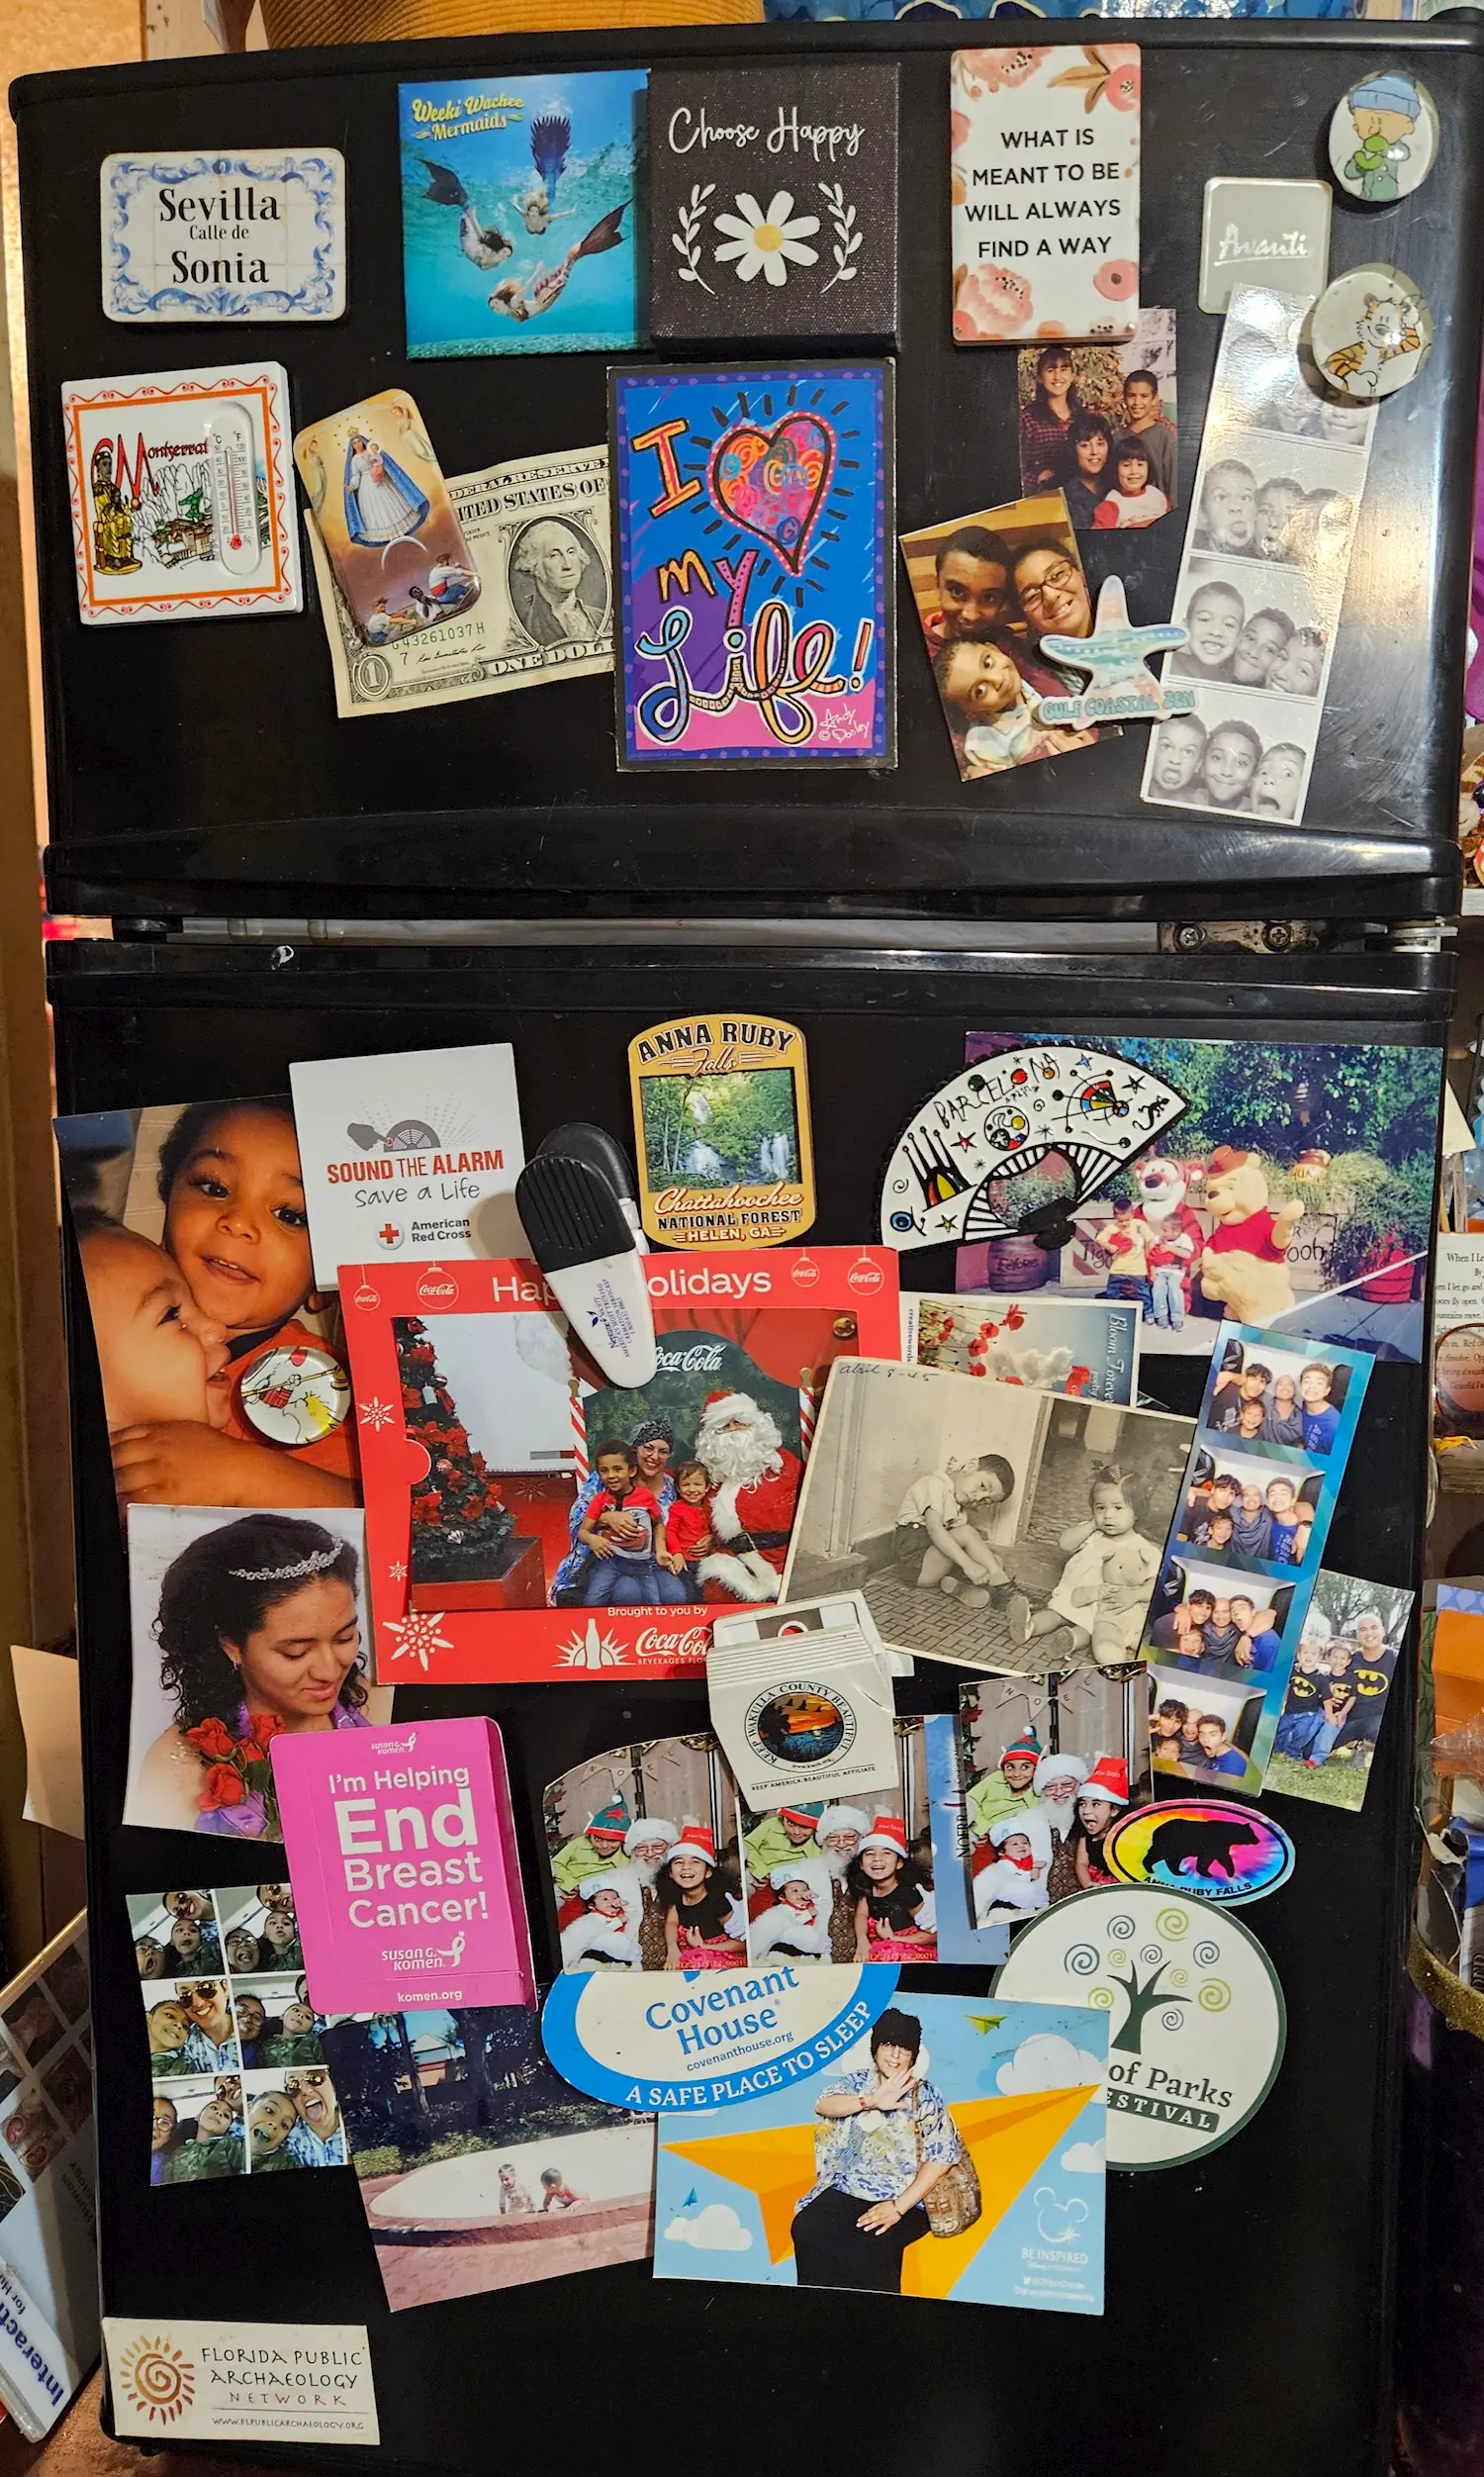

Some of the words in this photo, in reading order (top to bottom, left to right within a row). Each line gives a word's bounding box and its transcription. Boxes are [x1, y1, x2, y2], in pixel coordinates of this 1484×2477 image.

[412, 99, 462, 123] Weeki
[464, 92, 524, 115] Wachee
[431, 113, 508, 142] Mermaids
[668, 107, 760, 153] Choose
[767, 106, 865, 162] Happy
[1001, 130, 1068, 148] WHAT
[1075, 128, 1094, 145] IS
[973, 166, 1049, 186] MEANT
[1055, 164, 1084, 181] TO
[1092, 162, 1120, 180] BE
[158, 186, 281, 223] Sevilla
[965, 204, 1019, 223] WILL
[1026, 199, 1121, 220] ALWAYS
[189, 224, 227, 240] Calle
[232, 224, 249, 239] de
[978, 239, 1029, 257] FIND
[1036, 239, 1052, 255] A
[1059, 237, 1112, 254] WAY
[1218, 224, 1308, 255] Avanti
[171, 249, 270, 284] Sonia
[631, 418, 703, 520] I
[449, 476, 510, 499] DERAL
[458, 498, 501, 524] ITED
[504, 482, 577, 511] STATES
[580, 477, 607, 496] OF
[657, 547, 761, 629] my
[488, 653, 543, 675] ONE
[547, 639, 613, 663] DOLL
[636, 600, 873, 746] Life!
[819, 704, 856, 728] Andy
[1043, 701, 1082, 720] GULF
[1085, 694, 1159, 716] COASTAL
[1162, 690, 1196, 710] ZEN
[637, 1021, 713, 1064] ANNA
[720, 1019, 794, 1054] RUBY
[692, 1045, 739, 1076] Falls
[326, 1160, 394, 1184] SOUND
[397, 1156, 428, 1178] THE
[432, 1149, 505, 1176] ALARM
[417, 1186, 432, 1200] a
[441, 1178, 481, 1200] Life
[654, 1181, 804, 1215] Chattahoochee
[412, 1218, 470, 1231] American
[658, 1213, 736, 1231] NATIONAL
[741, 1208, 802, 1227] FOREST
[1292, 1226, 1301, 1238] R
[412, 1231, 435, 1243] Red
[436, 1230, 472, 1241] Cross
[688, 1228, 746, 1244] HELEN,
[749, 1226, 773, 1240] GA
[1286, 1234, 1324, 1264] ooh
[1446, 1252, 1469, 1263] When
[1471, 1253, 1475, 1262] I
[419, 1284, 455, 1296] Coca-Cola
[492, 1276, 560, 1306] Hap
[648, 1268, 772, 1299] olidays
[849, 1273, 881, 1284] Coca-Cola
[1109, 1313, 1128, 1355] Bloom
[607, 1607, 653, 1618] Brought
[656, 1607, 668, 1616] to
[670, 1607, 691, 1617] you
[694, 1605, 707, 1616] by
[635, 1626, 713, 1658] Coca-Col
[780, 1683, 831, 1696] COUNTY
[748, 1691, 777, 1737] WAKULLA
[832, 1695, 855, 1751] BEAUTIFUL
[752, 1741, 778, 1763] KEEP
[374, 1765, 470, 1791] Helping
[771, 1778, 801, 1788] AMERICA
[803, 1772, 841, 1782] BEAUTIFUL
[843, 1766, 877, 1776] AFFILIATE
[333, 1788, 479, 1856] End
[343, 1851, 484, 1893] Breast
[1217, 1882, 1252, 1895] FALLS
[348, 1891, 490, 1929] Cancer!
[397, 1989, 463, 2004] komen.org
[645, 1965, 800, 2031] Covenant
[677, 2006, 779, 2055] House
[625, 2084, 643, 2104] A
[648, 2086, 708, 2107] SAFE
[711, 2065, 785, 2103] PLACE
[783, 2050, 815, 2079] TO
[816, 2000, 872, 2059] SLEEP
[687, 2031, 794, 2072] covenanthouse.org
[1108, 2060, 1143, 2085] of
[1145, 2067, 1233, 2108] Parks
[1107, 2090, 1211, 2129] ESTIVAL
[1021, 2247, 1035, 2259] BE
[1037, 2249, 1088, 2264] INSPIRED
[201, 2347, 287, 2365] FLORIDA
[294, 2351, 363, 2366] PUBLIC
[211, 2369, 358, 2389] ARCHAEOLOGY
[229, 2391, 347, 2407] NETWORK
